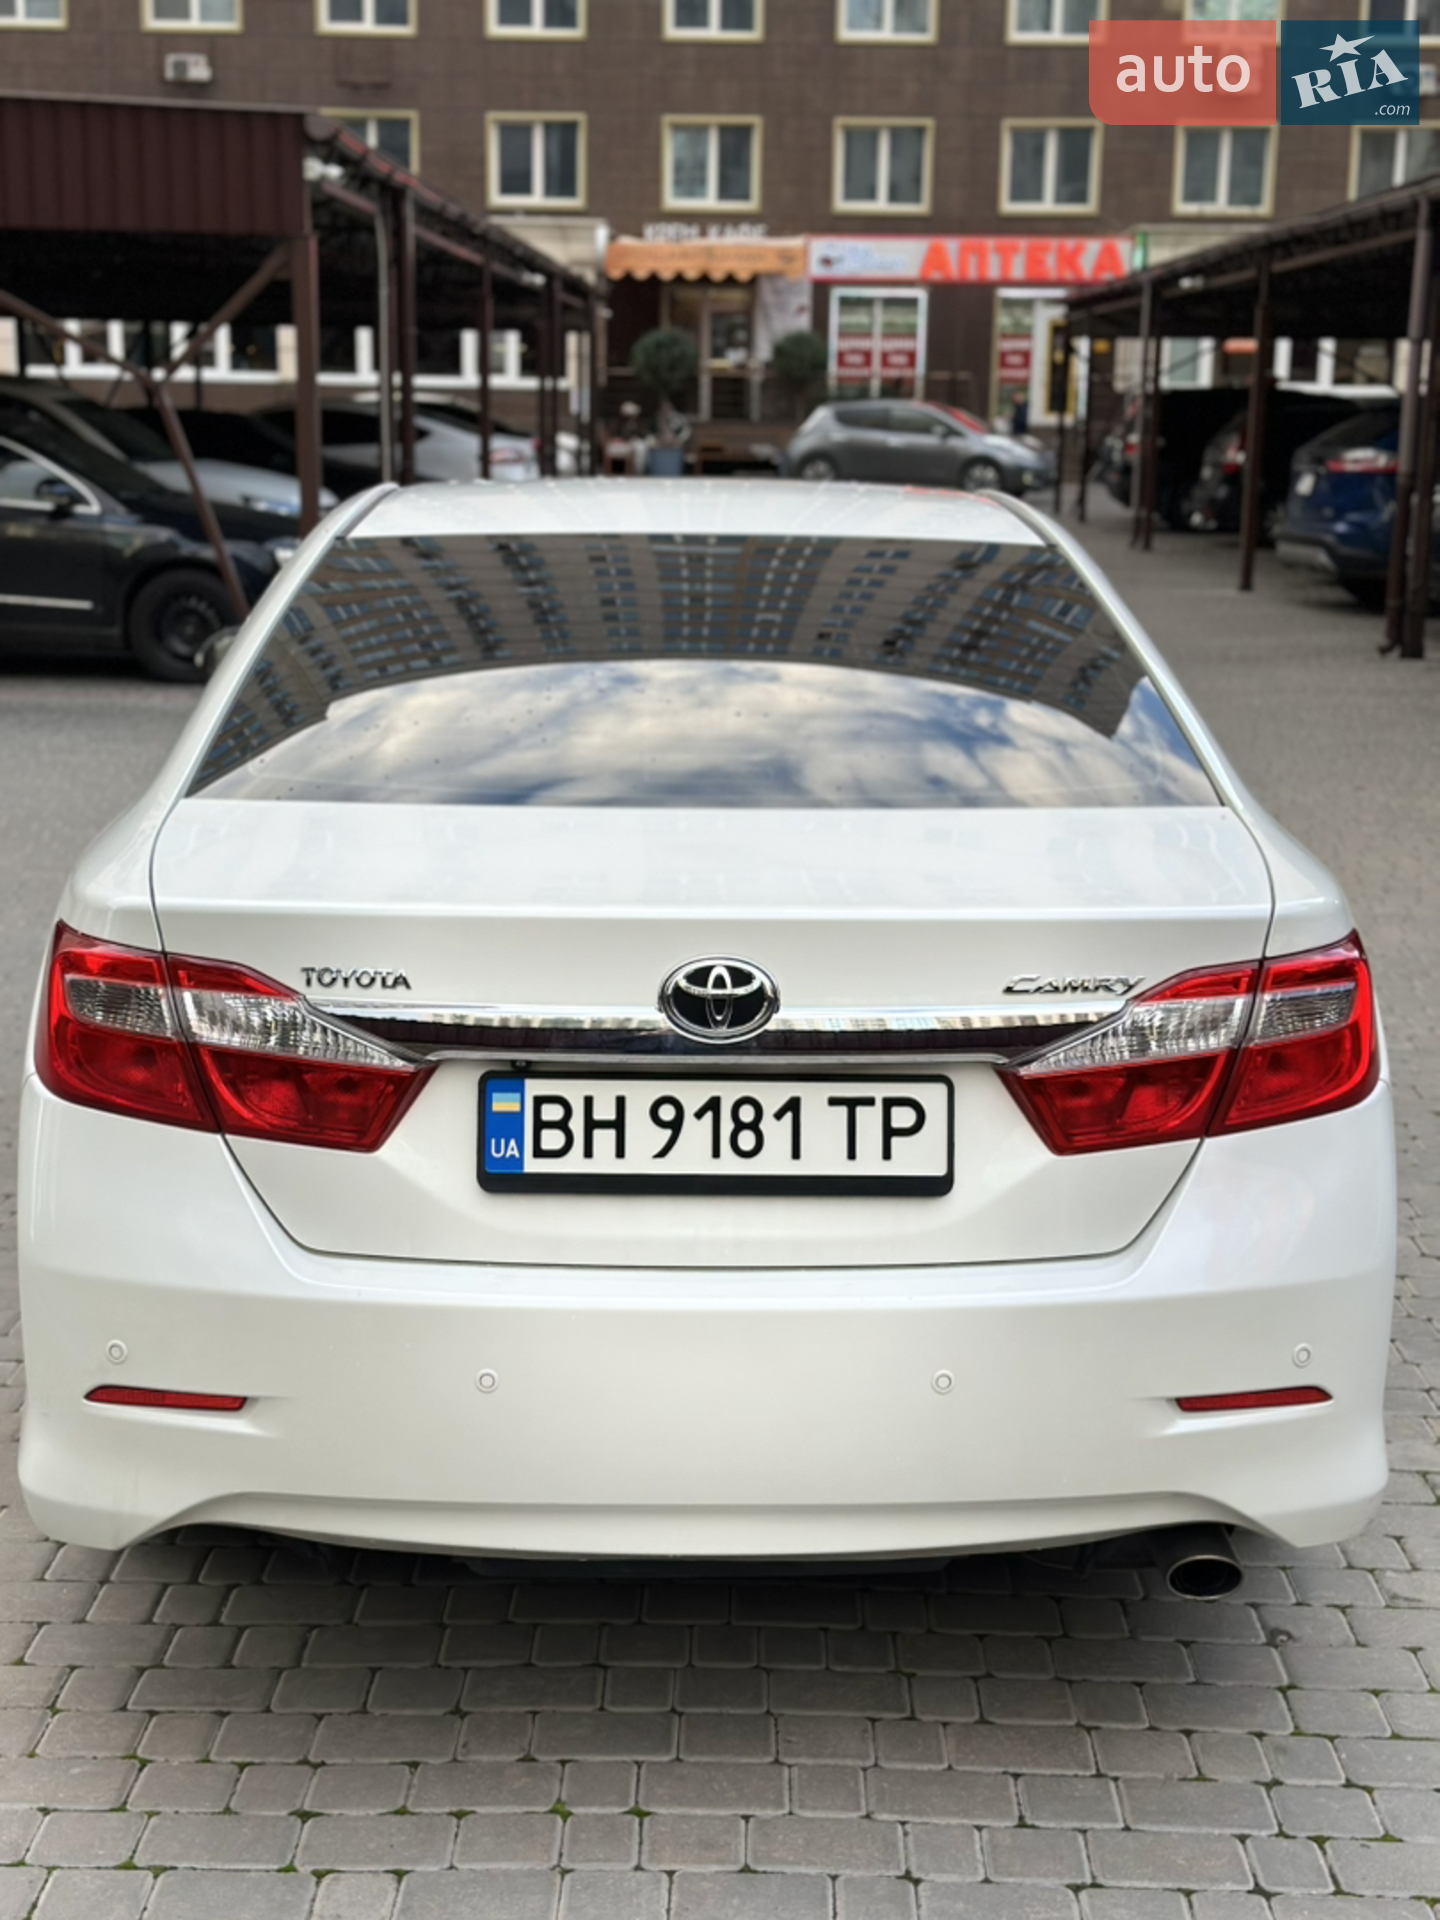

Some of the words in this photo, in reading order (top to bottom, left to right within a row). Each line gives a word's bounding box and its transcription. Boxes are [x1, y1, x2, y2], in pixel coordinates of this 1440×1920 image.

[918, 237, 1127, 281] АПТЕКА
[300, 966, 412, 990] TOYOTA
[1002, 973, 1146, 996] CAMRY
[532, 1094, 627, 1160] BH
[648, 1095, 802, 1161] 9181
[827, 1096, 927, 1161] TP
[490, 1137, 521, 1159] UA
